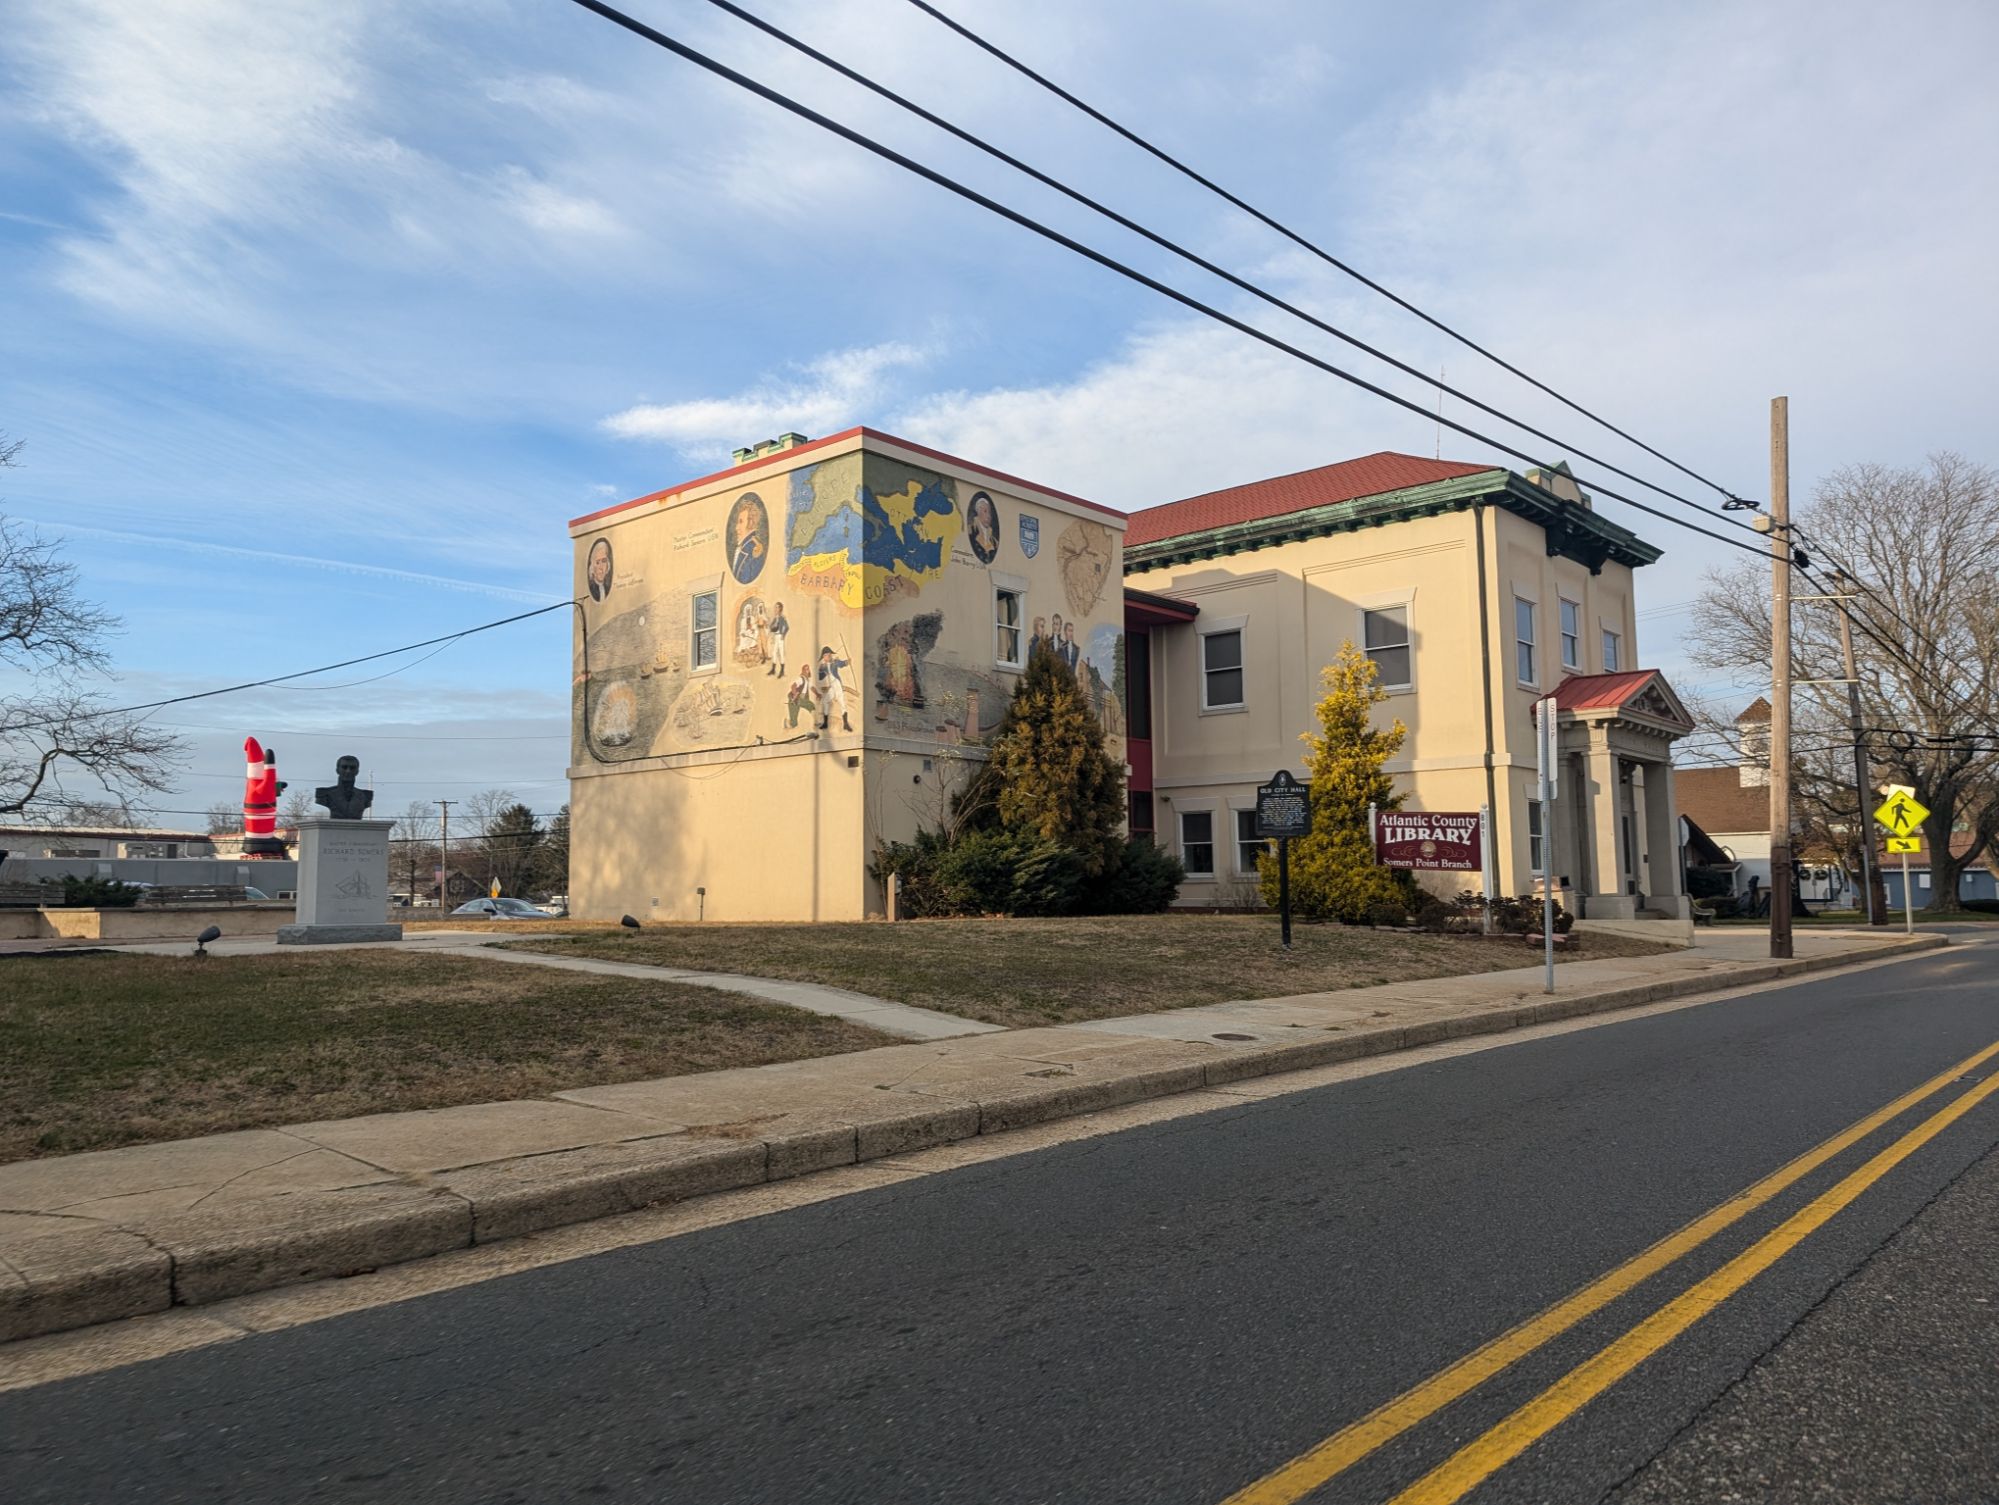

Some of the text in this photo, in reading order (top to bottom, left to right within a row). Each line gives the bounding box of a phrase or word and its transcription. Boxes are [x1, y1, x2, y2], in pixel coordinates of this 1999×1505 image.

[800, 573, 855, 595] BARBARY
[864, 574, 904, 600] COAST
[1379, 814, 1478, 829] Atlantic County
[1384, 827, 1473, 846] LIBRARY
[1383, 858, 1473, 869] Somers Point Branch
